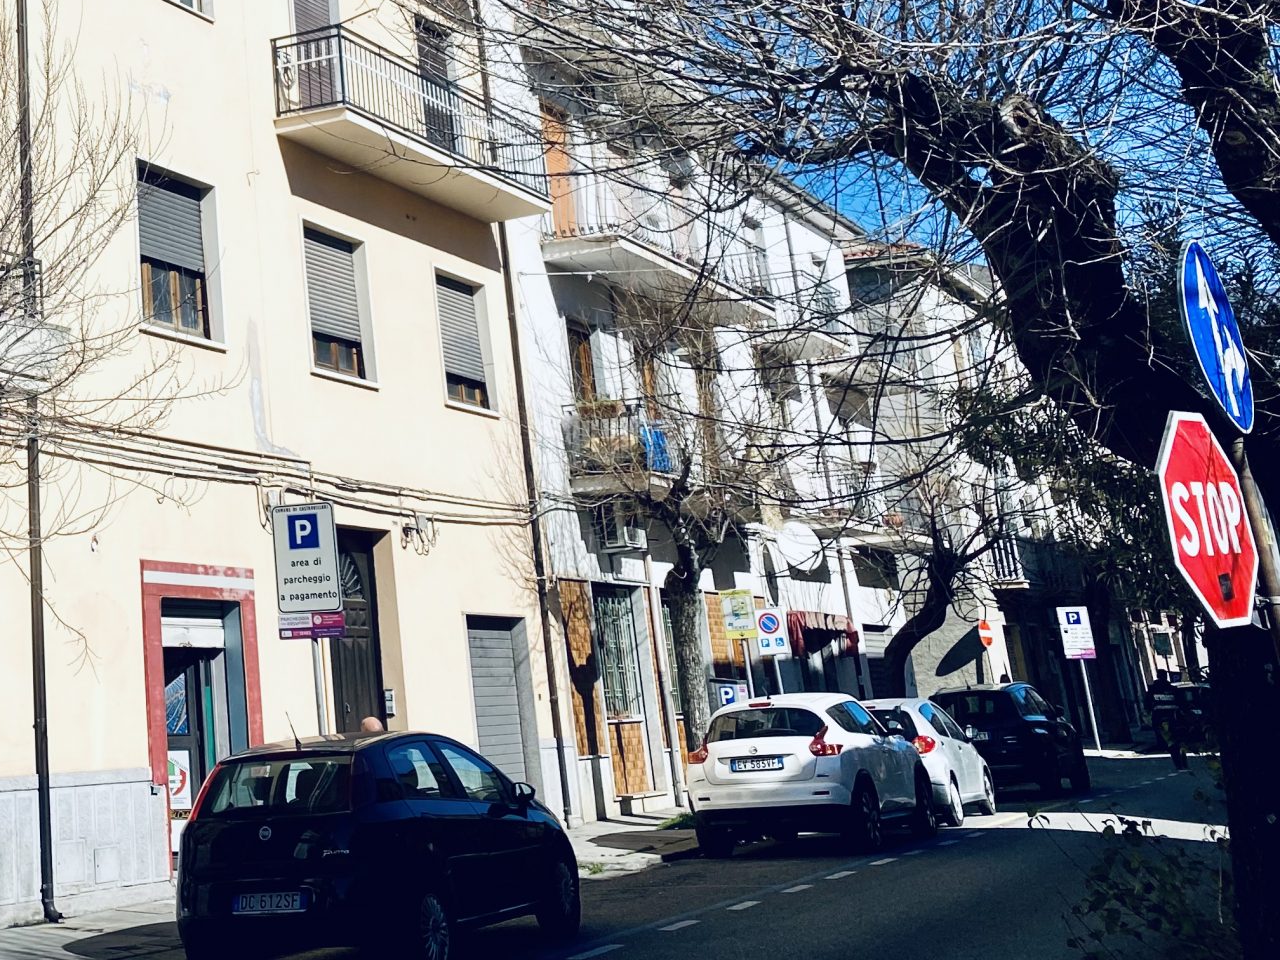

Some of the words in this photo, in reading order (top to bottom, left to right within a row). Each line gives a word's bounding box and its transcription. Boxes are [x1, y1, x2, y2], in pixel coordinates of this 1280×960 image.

[1171, 481, 1242, 557] STOP
[294, 519, 312, 545] P
[290, 559, 309, 567] area
[313, 557, 322, 566] di
[283, 573, 331, 586] parcheggio
[280, 593, 286, 601] a
[289, 589, 338, 602] pagamento
[1069, 612, 1078, 624] P
[720, 687, 734, 705] P
[240, 895, 255, 910] DC
[260, 893, 299, 910] 612SF
